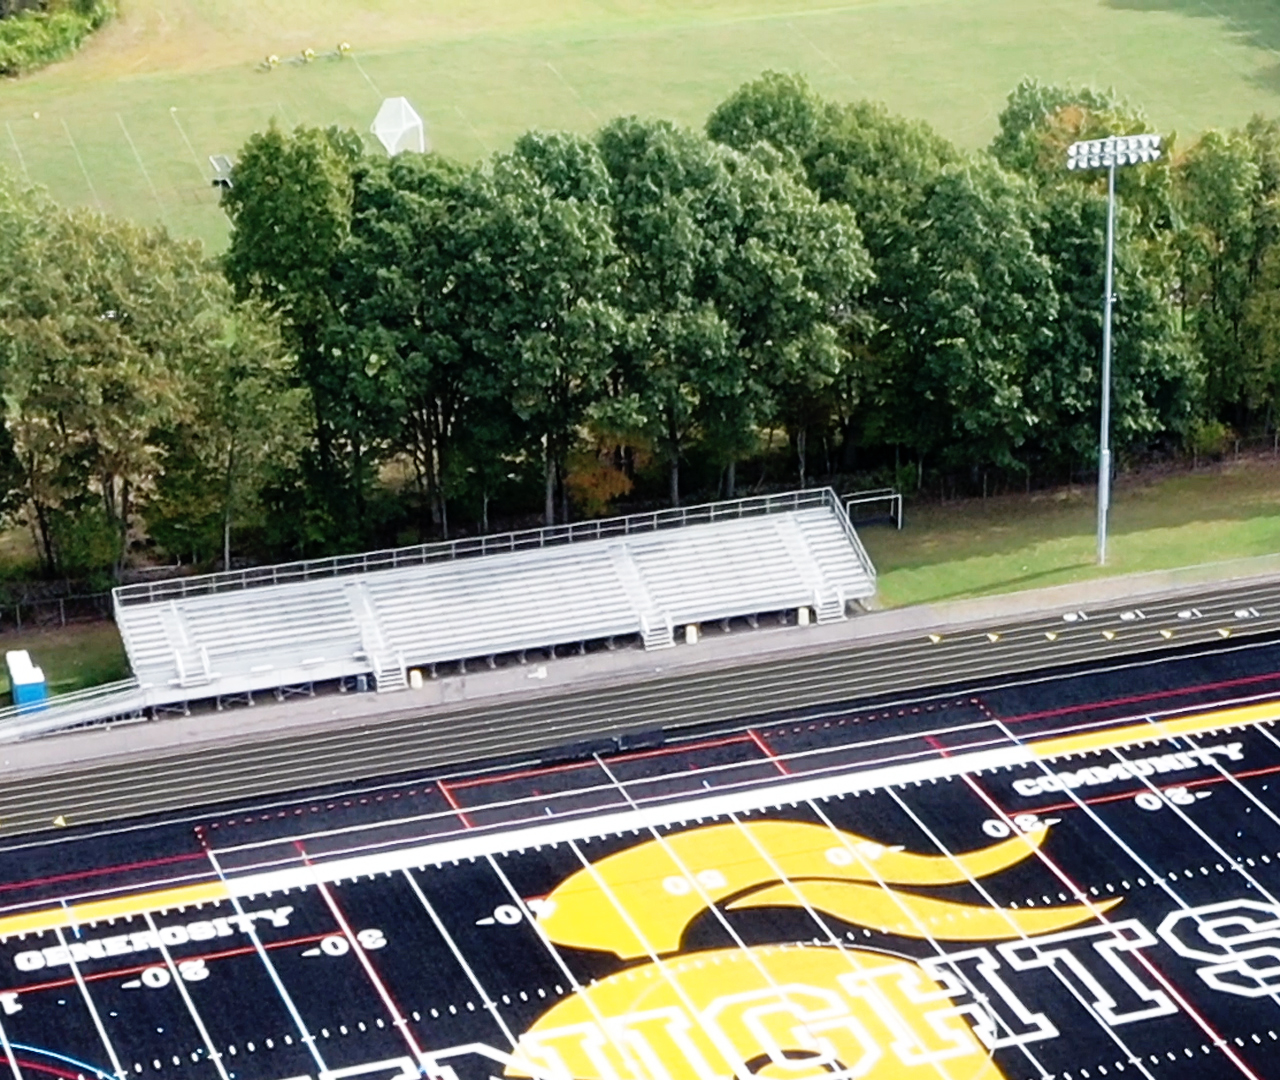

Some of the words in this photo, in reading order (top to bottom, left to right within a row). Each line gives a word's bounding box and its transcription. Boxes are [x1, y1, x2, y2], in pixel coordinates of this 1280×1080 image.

[1011, 743, 1245, 798] COMMUNITY
[1134, 787, 1198, 811] 20
[13, 906, 295, 973] GENEROSITY
[320, 927, 388, 957] 30
[140, 958, 211, 989] 20
